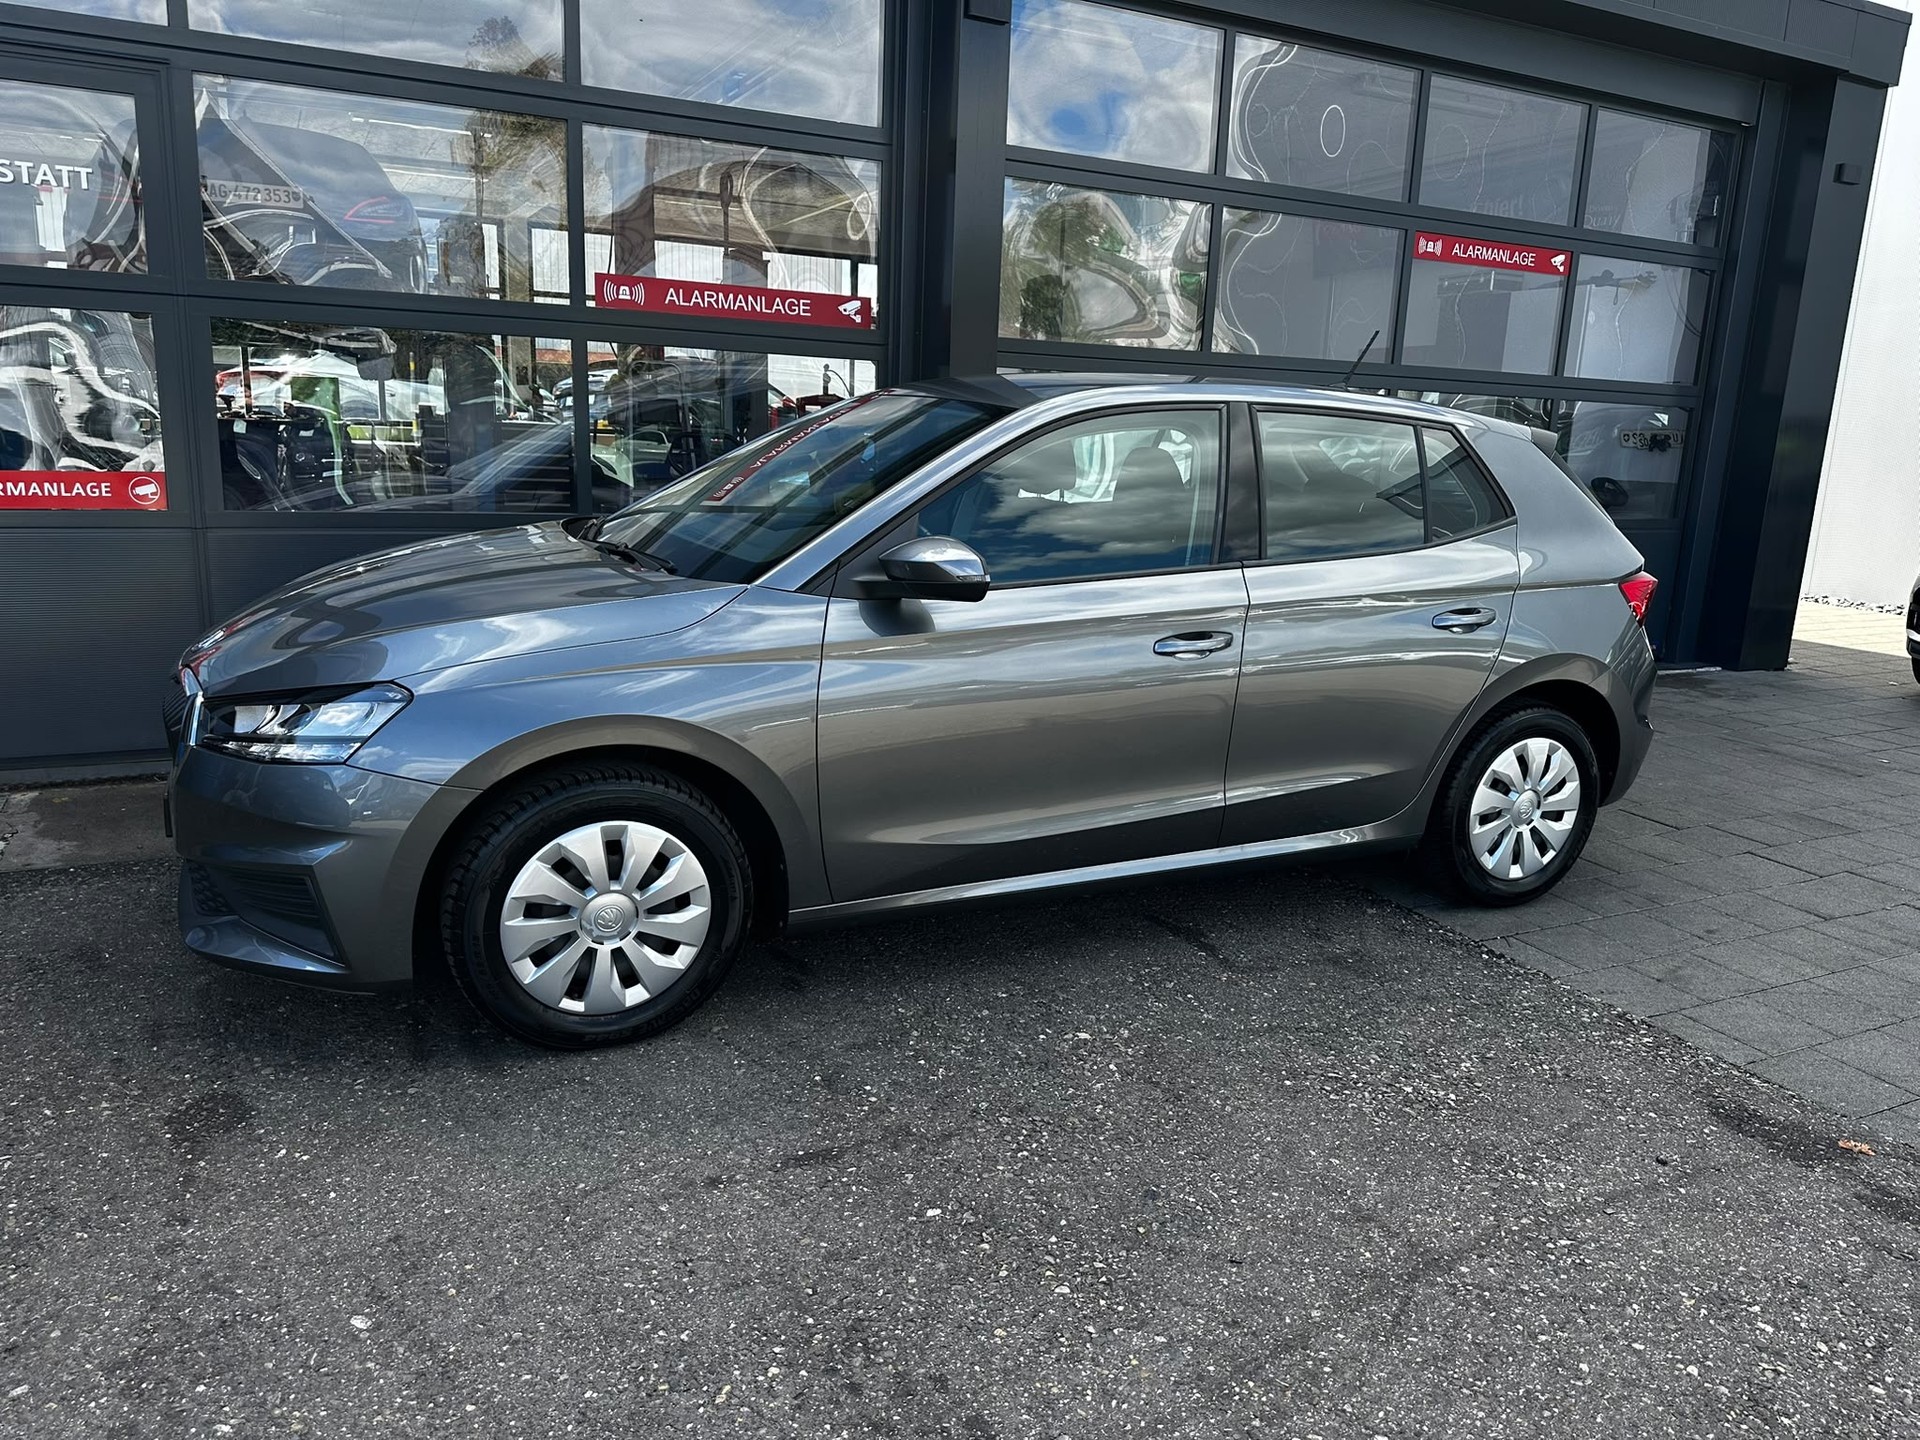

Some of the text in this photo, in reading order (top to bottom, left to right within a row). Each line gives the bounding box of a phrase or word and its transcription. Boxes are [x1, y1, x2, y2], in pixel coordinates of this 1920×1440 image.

[0, 158, 93, 190] STATT
[1451, 242, 1536, 268] ALARMANLAGE
[664, 287, 811, 316] ALARMANLAGE
